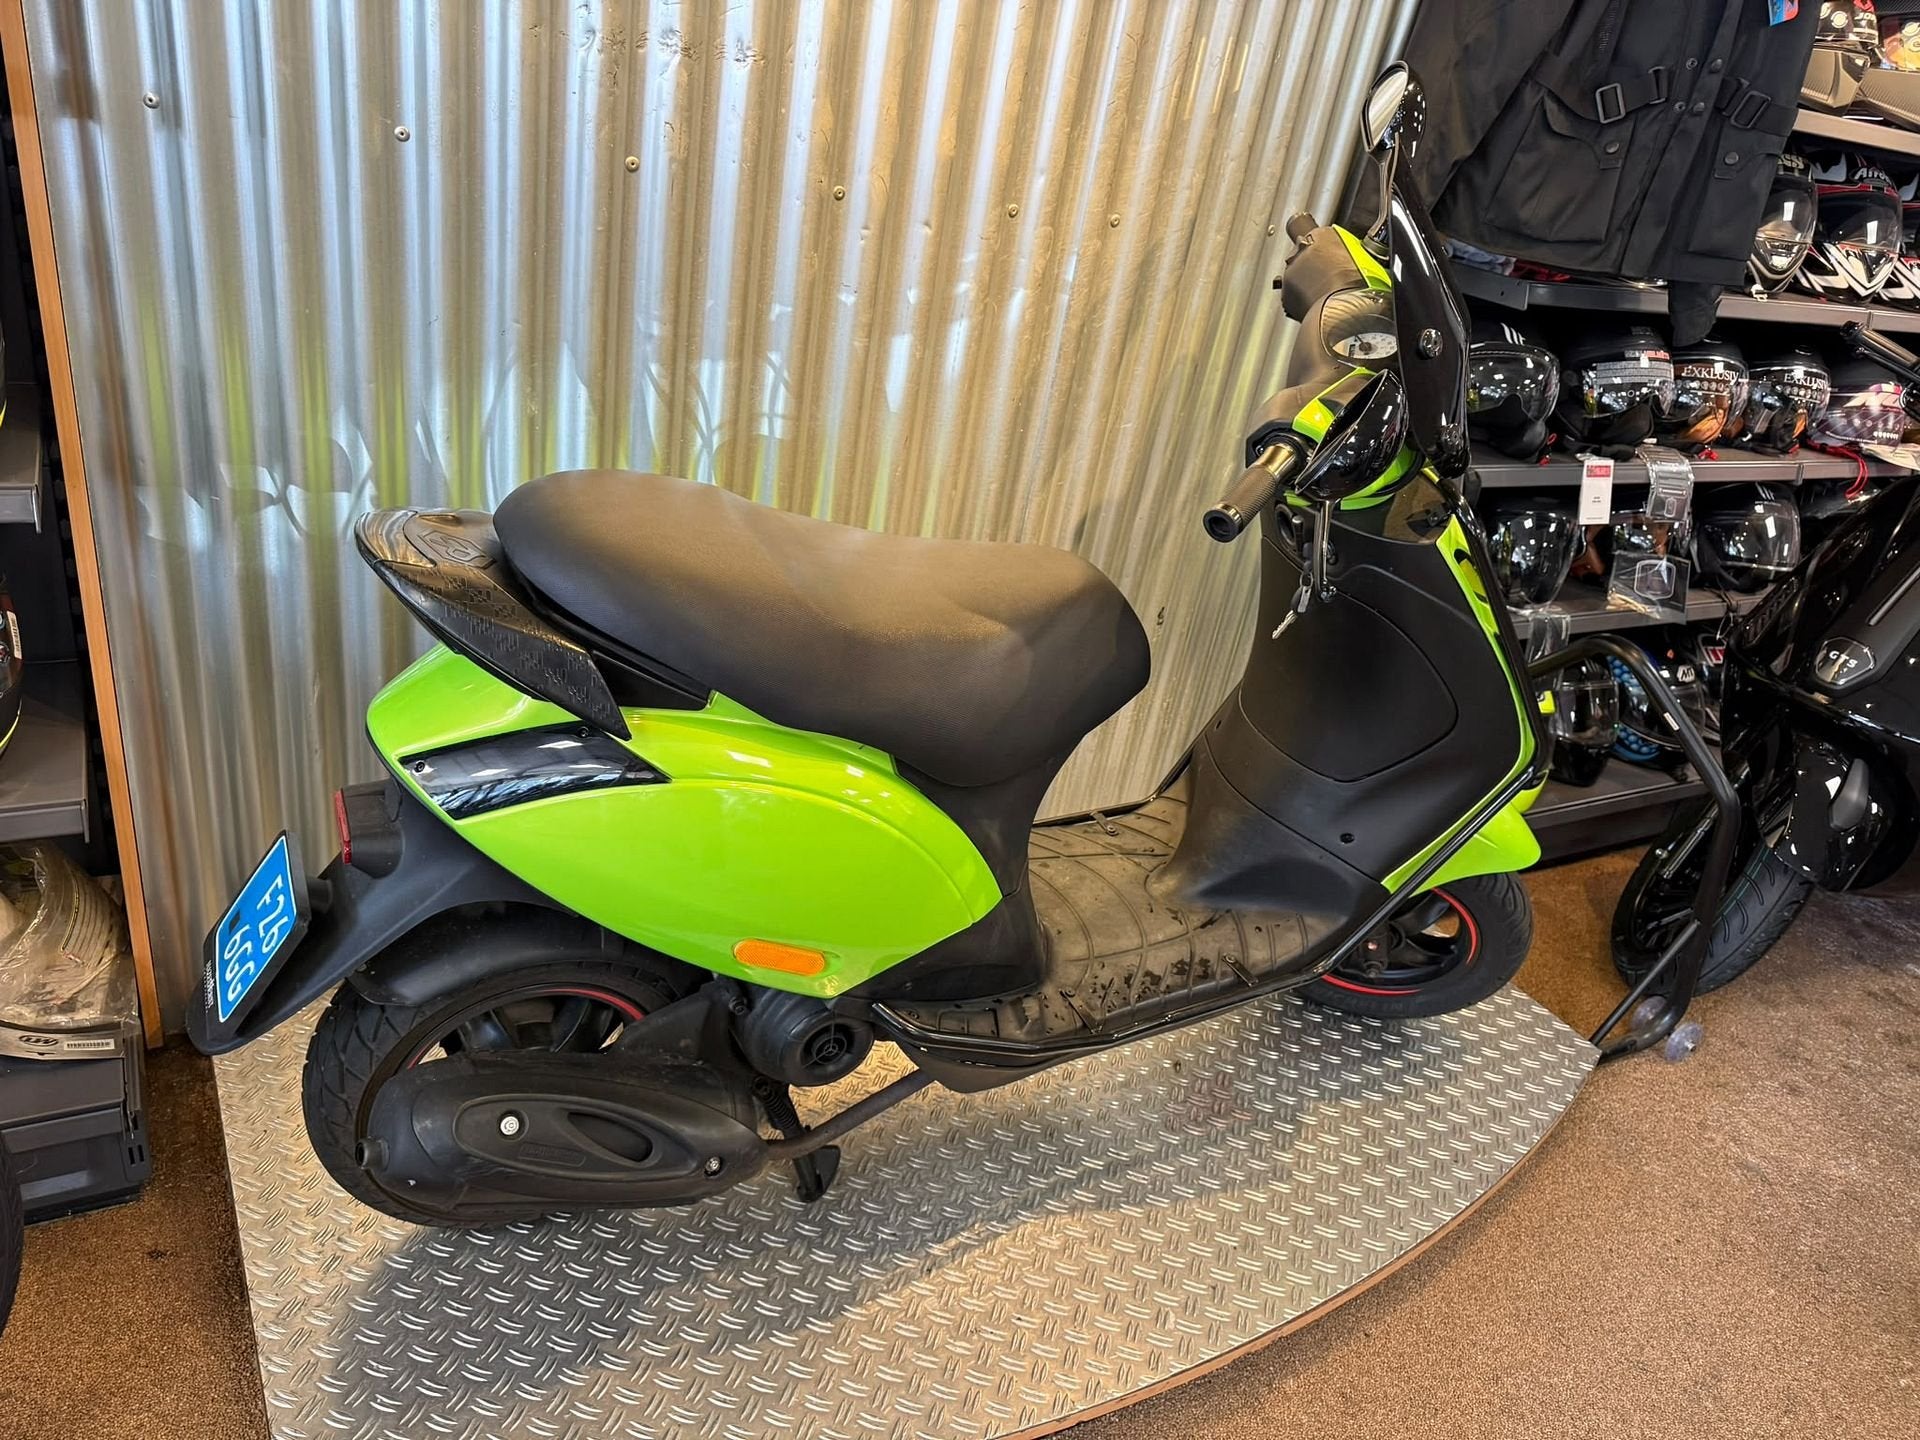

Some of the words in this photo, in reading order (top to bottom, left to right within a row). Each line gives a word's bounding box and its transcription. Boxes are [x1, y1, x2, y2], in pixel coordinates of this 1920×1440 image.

[1828, 650, 1858, 668] GTS
[257, 873, 289, 954] F26
[224, 924, 255, 1002] 6GG
